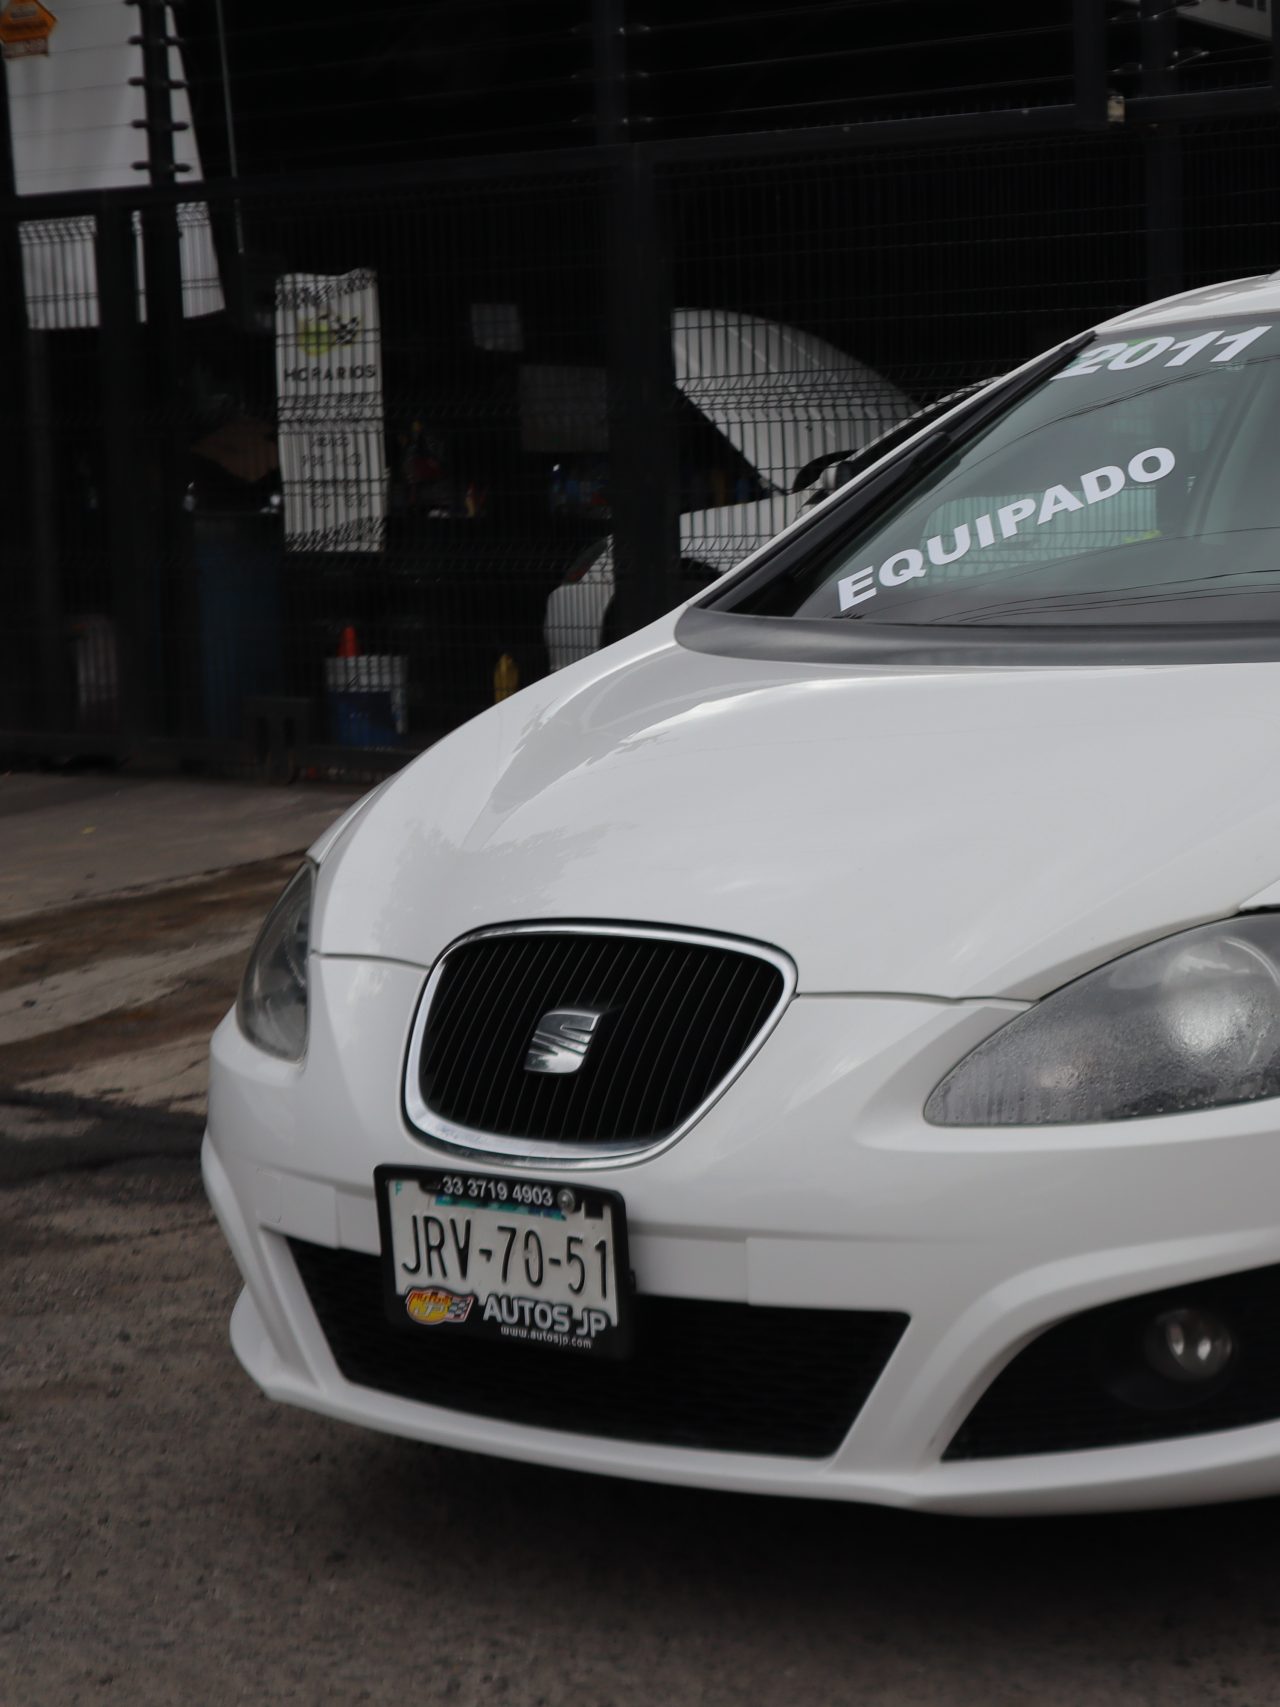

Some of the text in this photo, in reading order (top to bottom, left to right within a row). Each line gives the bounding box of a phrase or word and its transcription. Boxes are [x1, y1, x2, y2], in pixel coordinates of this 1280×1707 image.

[1052, 325, 1272, 380] 2011
[837, 447, 1177, 612] EQUIPADO
[443, 1176, 554, 1207] 33 3719 4903
[402, 1214, 608, 1300] JRV-70-51
[483, 1297, 607, 1338] AUTOS JP
[500, 1325, 592, 1349] www.autosjp.com
